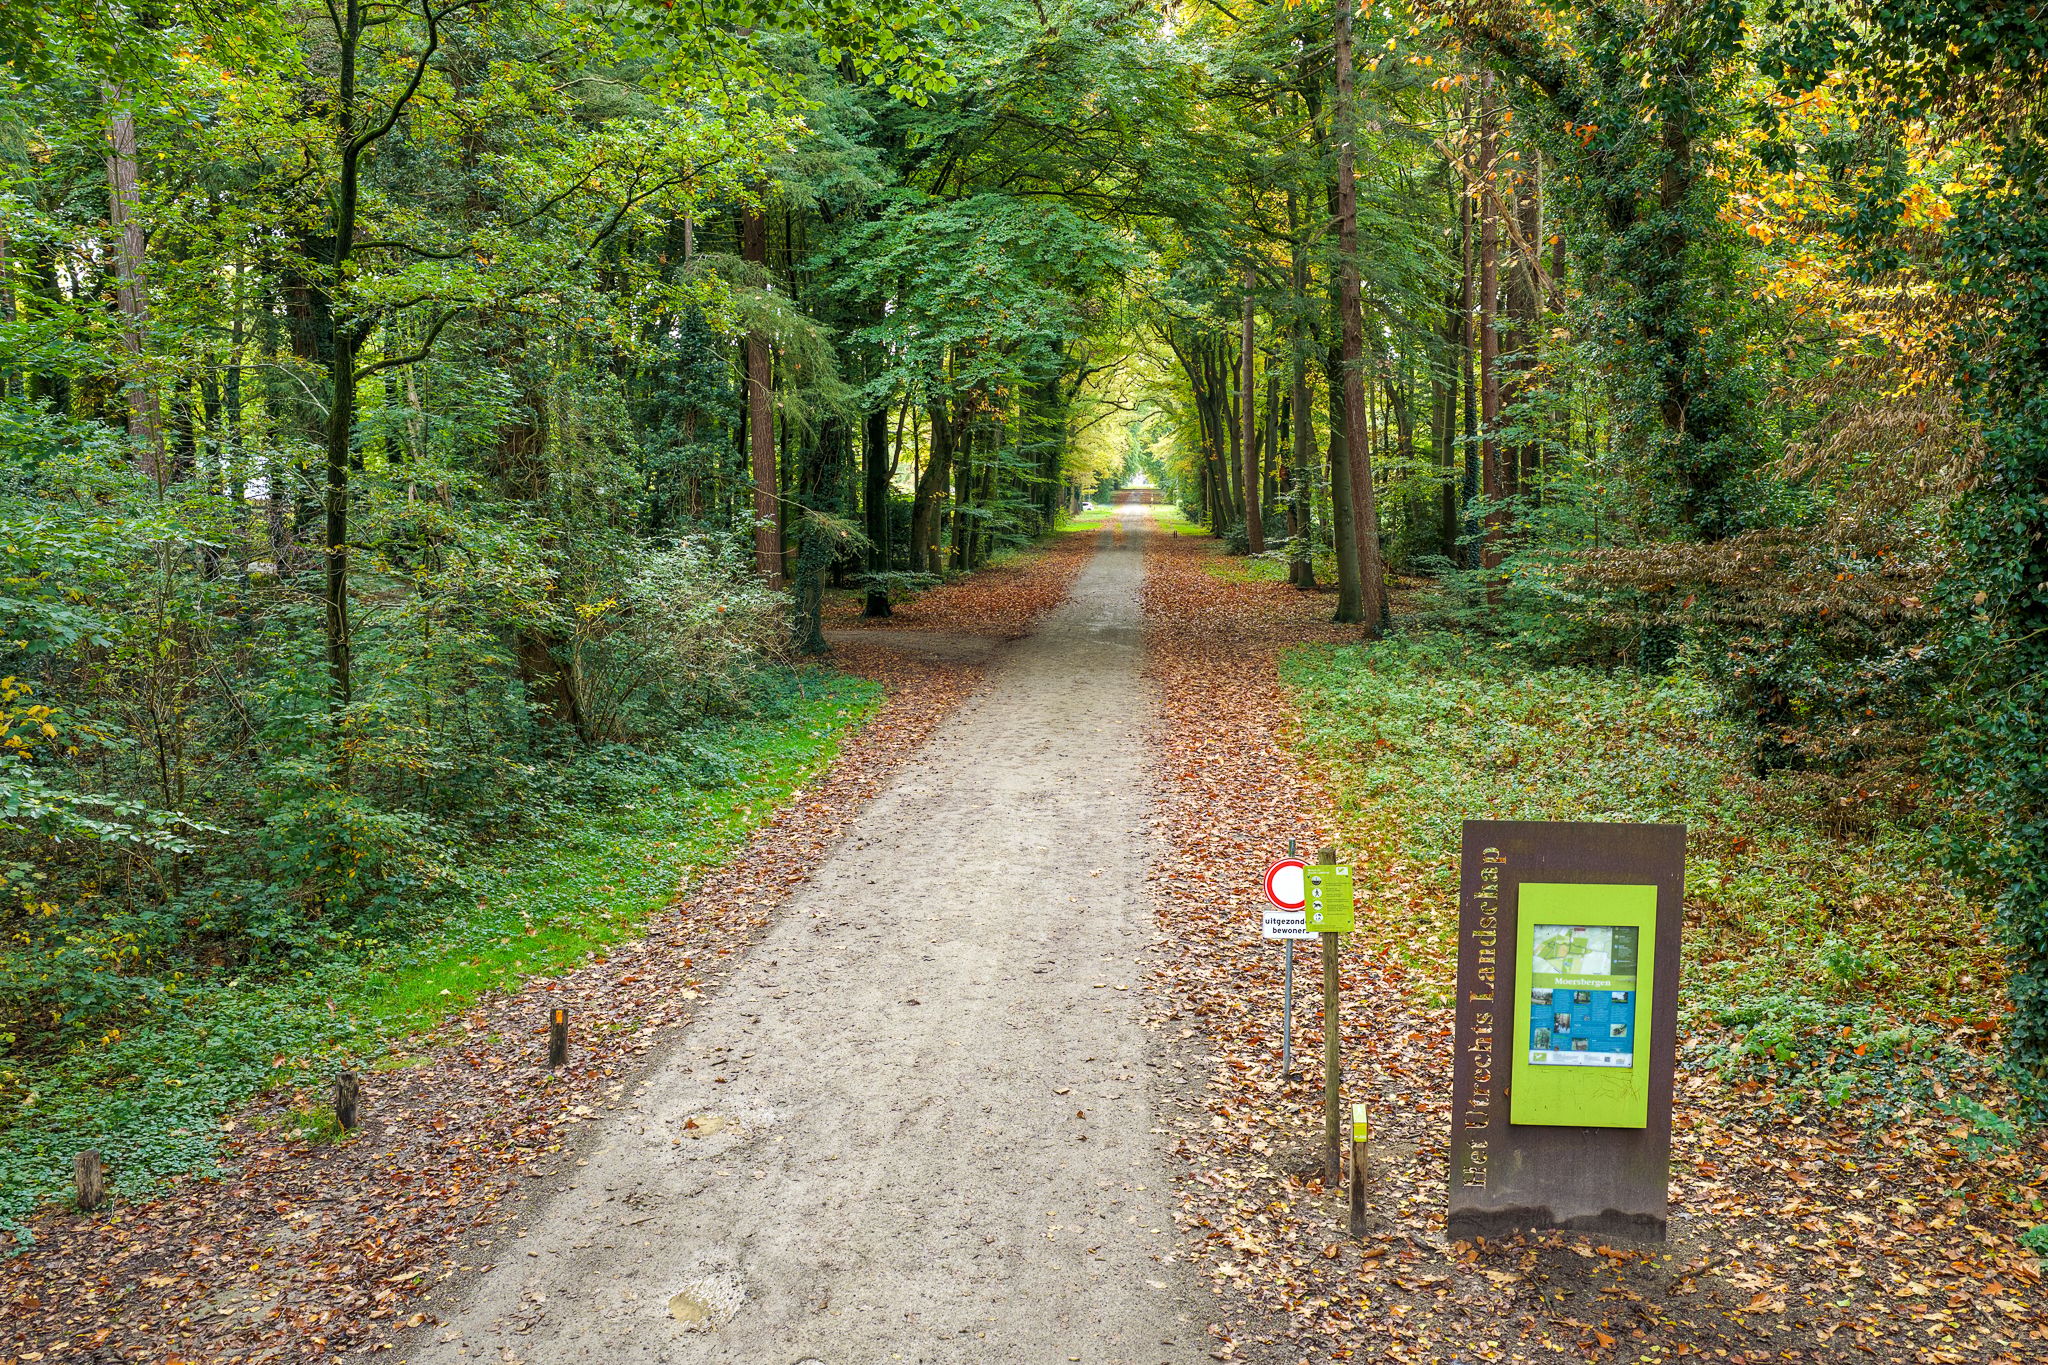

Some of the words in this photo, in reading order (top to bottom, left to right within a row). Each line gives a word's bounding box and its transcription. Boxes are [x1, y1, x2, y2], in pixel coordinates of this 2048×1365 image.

[1265, 917, 1307, 926] uitgezond
[1469, 847, 1507, 1004] Landschap
[1554, 977, 1611, 988] Moersbergen
[1464, 1012, 1494, 1129] Utrechts
[1463, 1139, 1489, 1190] Het
